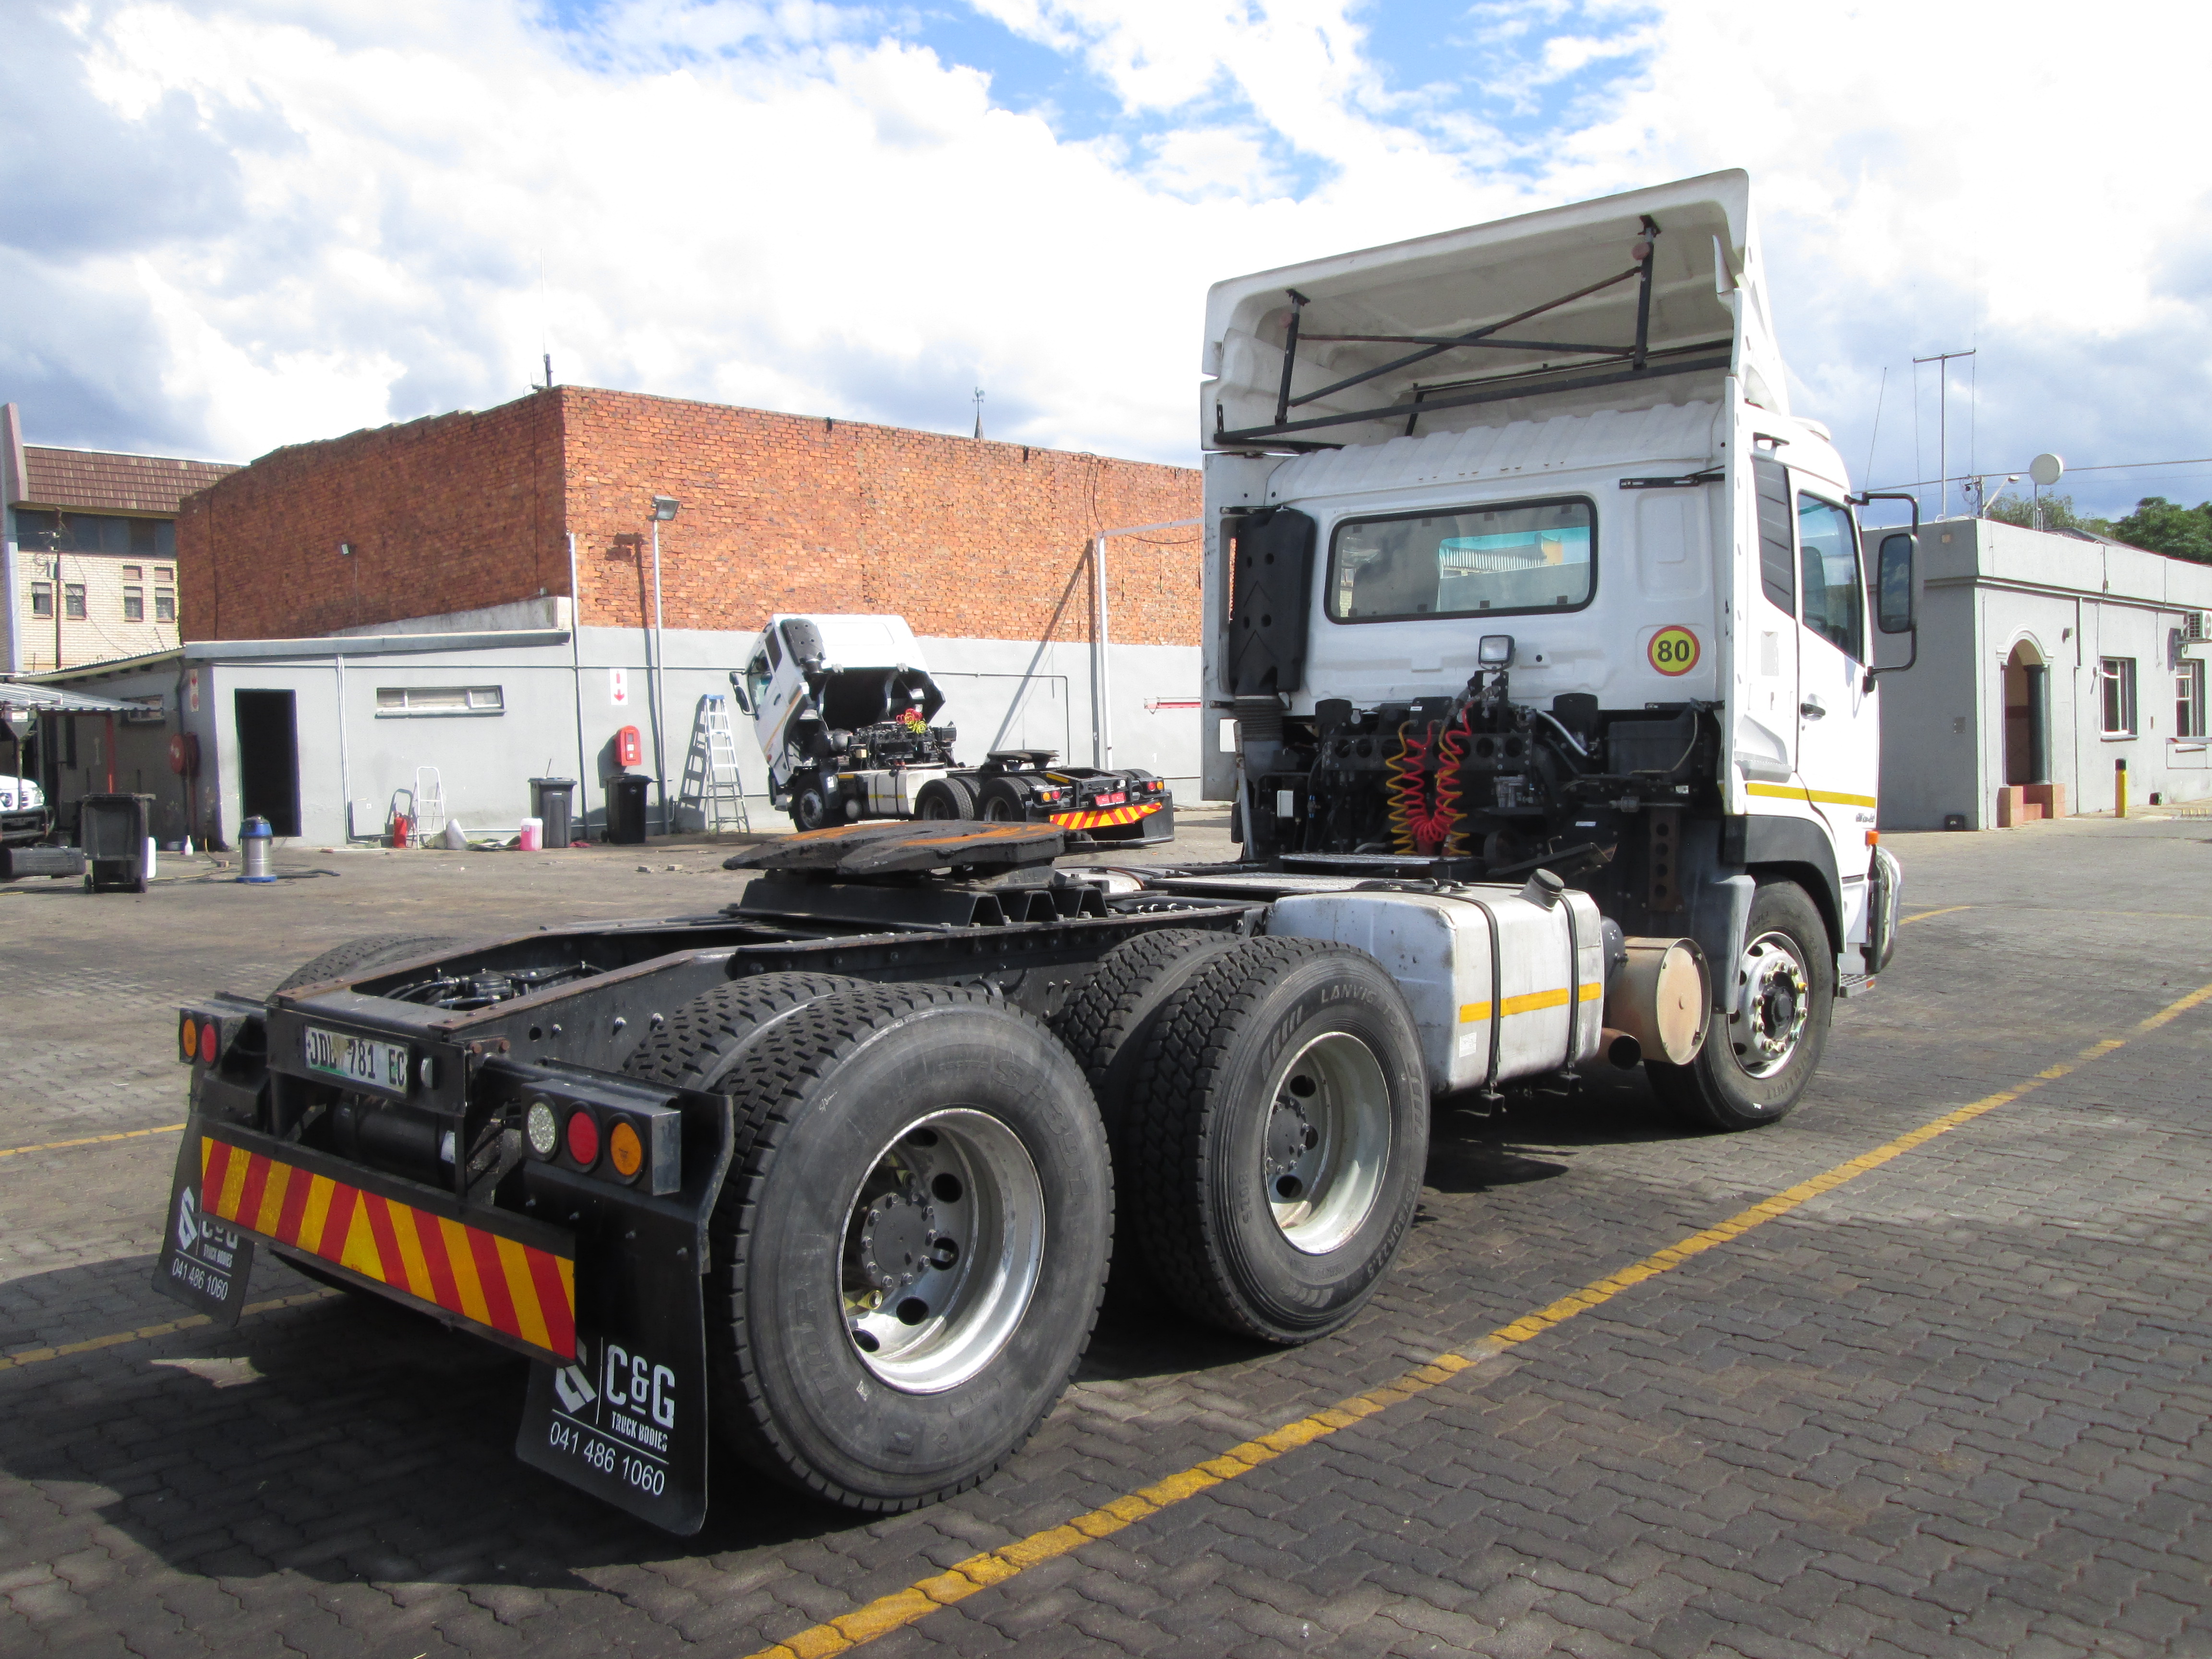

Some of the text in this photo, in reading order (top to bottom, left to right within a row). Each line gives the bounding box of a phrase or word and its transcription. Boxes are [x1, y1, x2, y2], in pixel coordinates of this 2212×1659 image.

[1657, 639, 1690, 662] 80
[310, 1032, 405, 1087] JDL 781 EC
[172, 1258, 228, 1301] 041 486 1060
[606, 1344, 676, 1429] C&G
[612, 1410, 668, 1453] TRUCK BODIES
[550, 1421, 665, 1496] 041 486 1060
